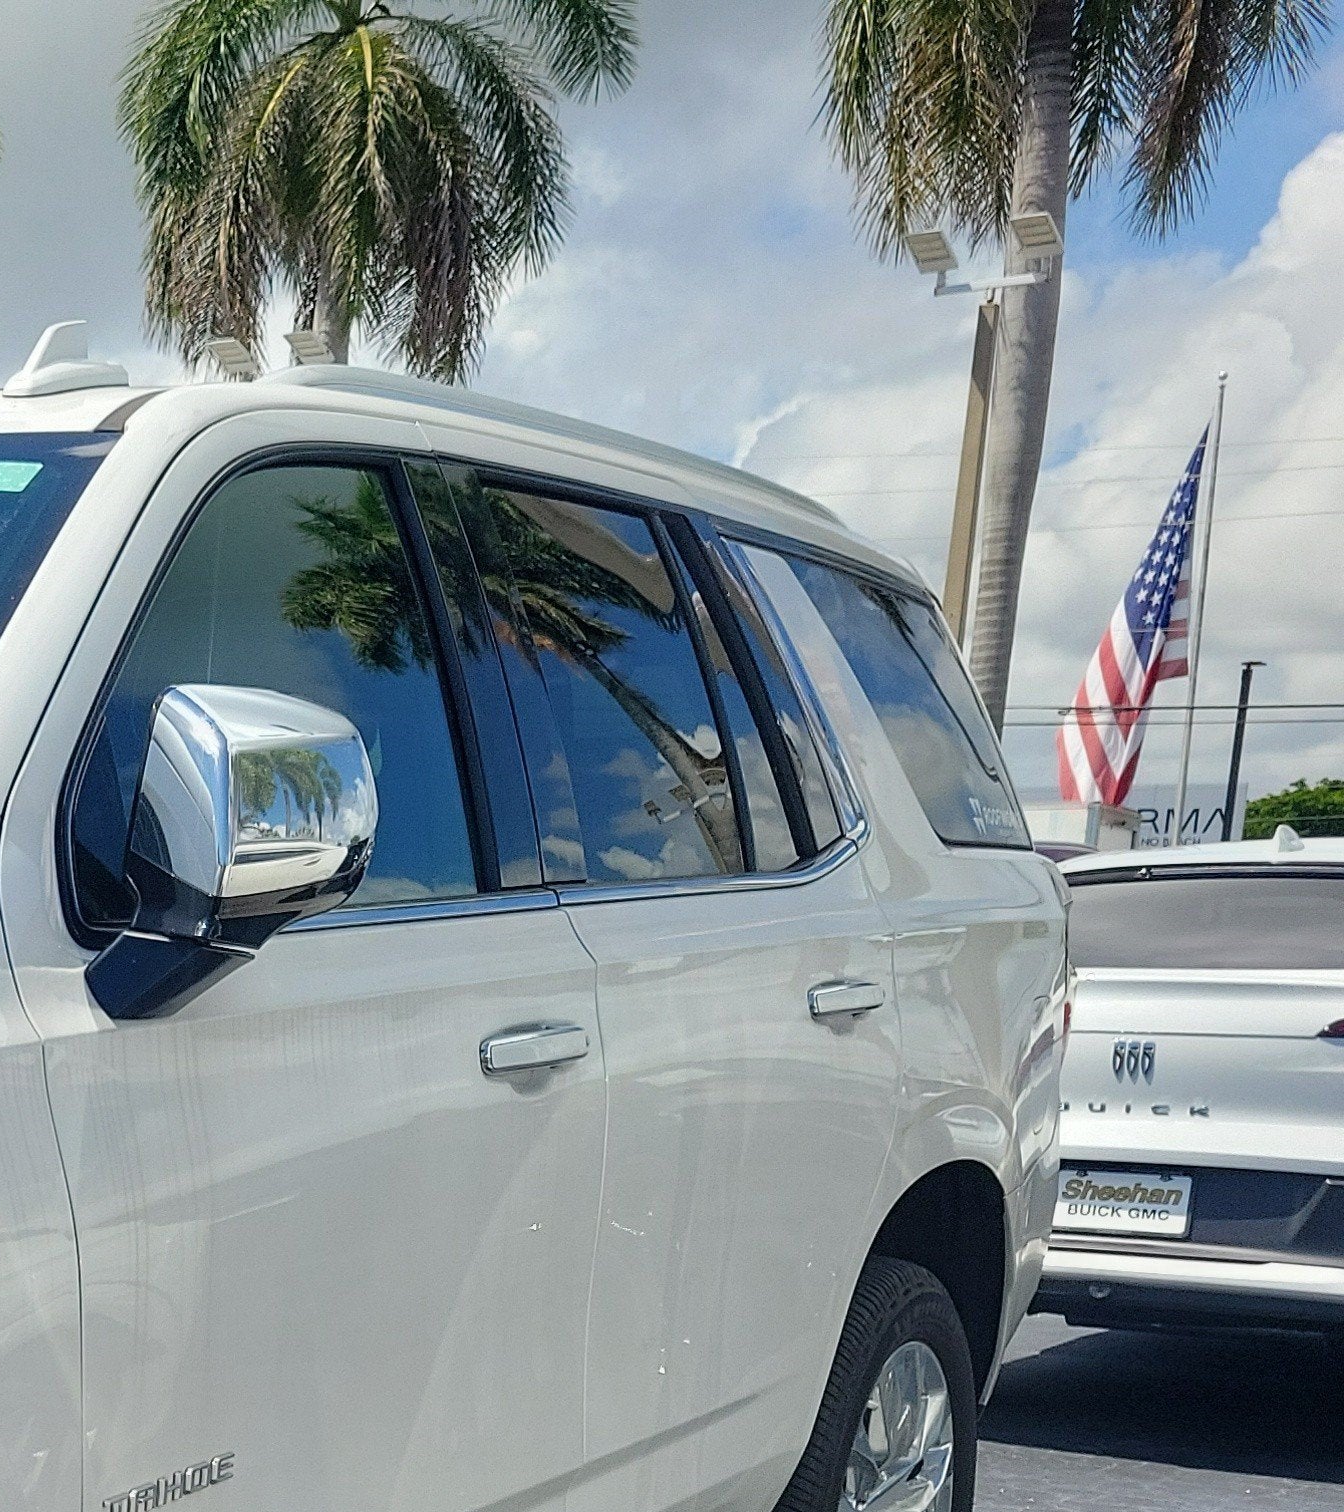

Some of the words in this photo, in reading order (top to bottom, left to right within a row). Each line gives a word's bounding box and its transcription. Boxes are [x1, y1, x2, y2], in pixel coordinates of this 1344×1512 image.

[1062, 1178, 1183, 1206] Sheehan
[1068, 1203, 1121, 1218] BUICK
[1128, 1207, 1170, 1221] GMC
